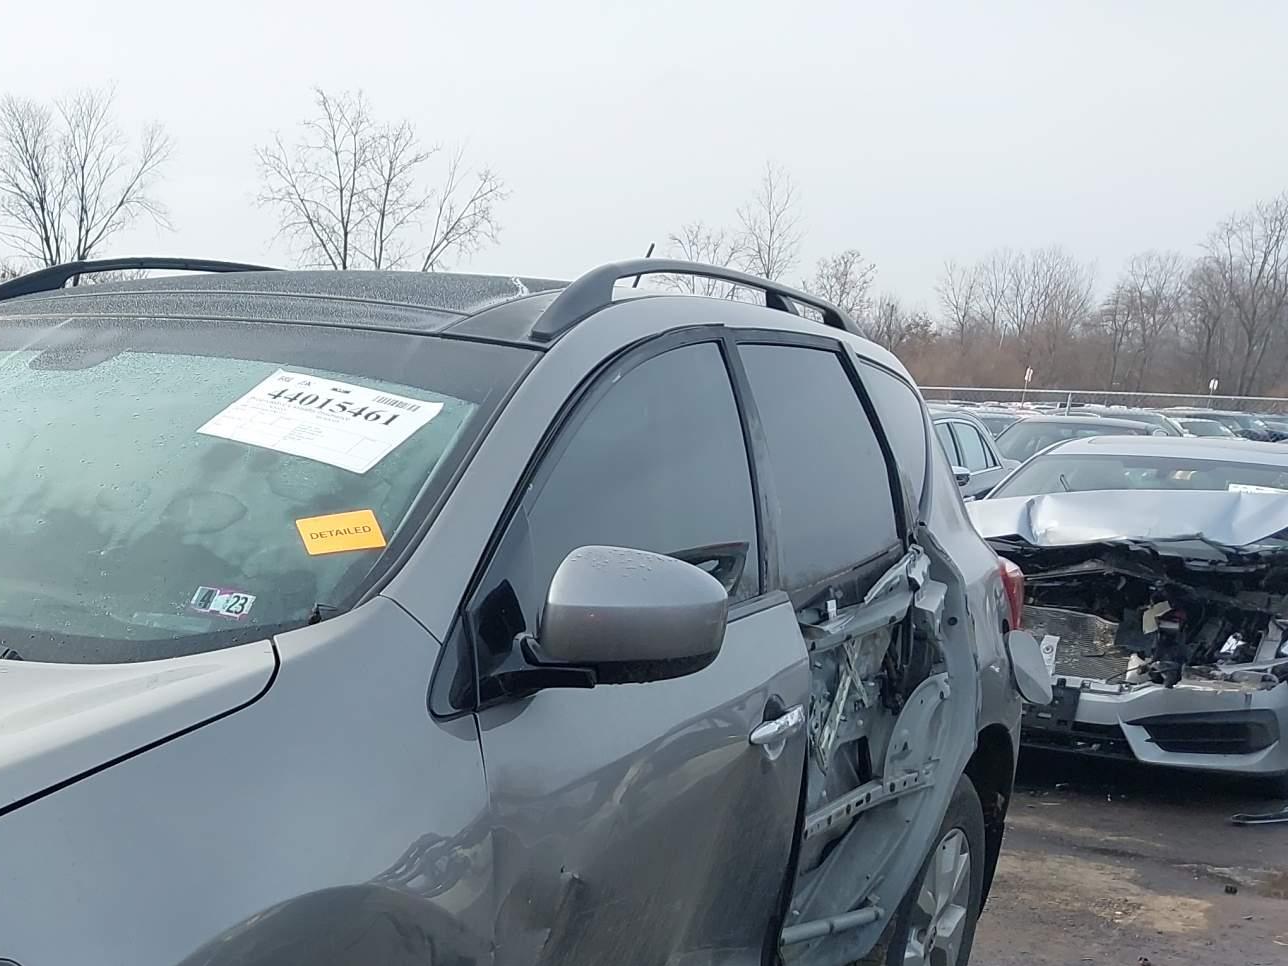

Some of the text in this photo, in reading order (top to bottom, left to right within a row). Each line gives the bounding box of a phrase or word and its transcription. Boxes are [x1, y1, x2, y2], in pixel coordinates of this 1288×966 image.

[266, 388, 400, 426] 44015461
[309, 524, 372, 541] DETAILED
[198, 589, 249, 614] 4 23
